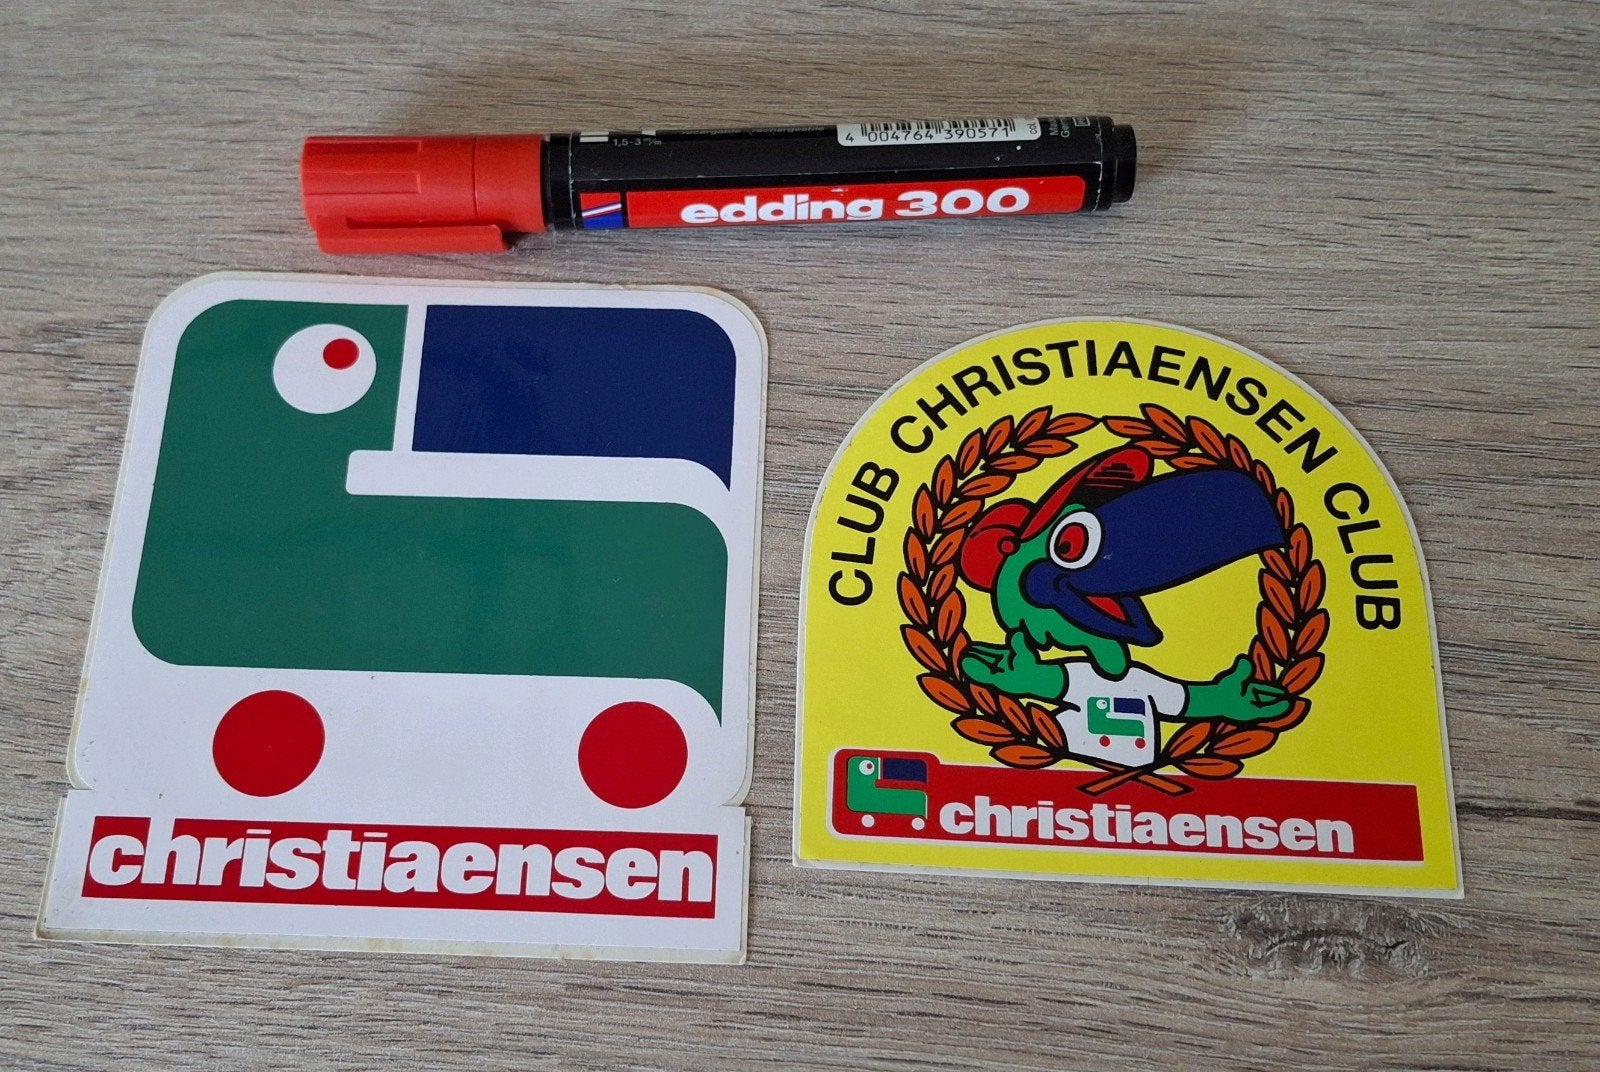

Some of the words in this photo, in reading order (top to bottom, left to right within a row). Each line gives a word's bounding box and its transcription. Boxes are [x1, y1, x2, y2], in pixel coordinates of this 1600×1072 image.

[681, 194, 883, 222] edding
[895, 187, 1030, 216] 300
[829, 462, 899, 606] CLUB
[891, 340, 1338, 474] CHRISTIAENSEN
[1324, 483, 1401, 630] CLUB
[940, 796, 1354, 852] christiaensen
[90, 818, 712, 902] christiaensen
